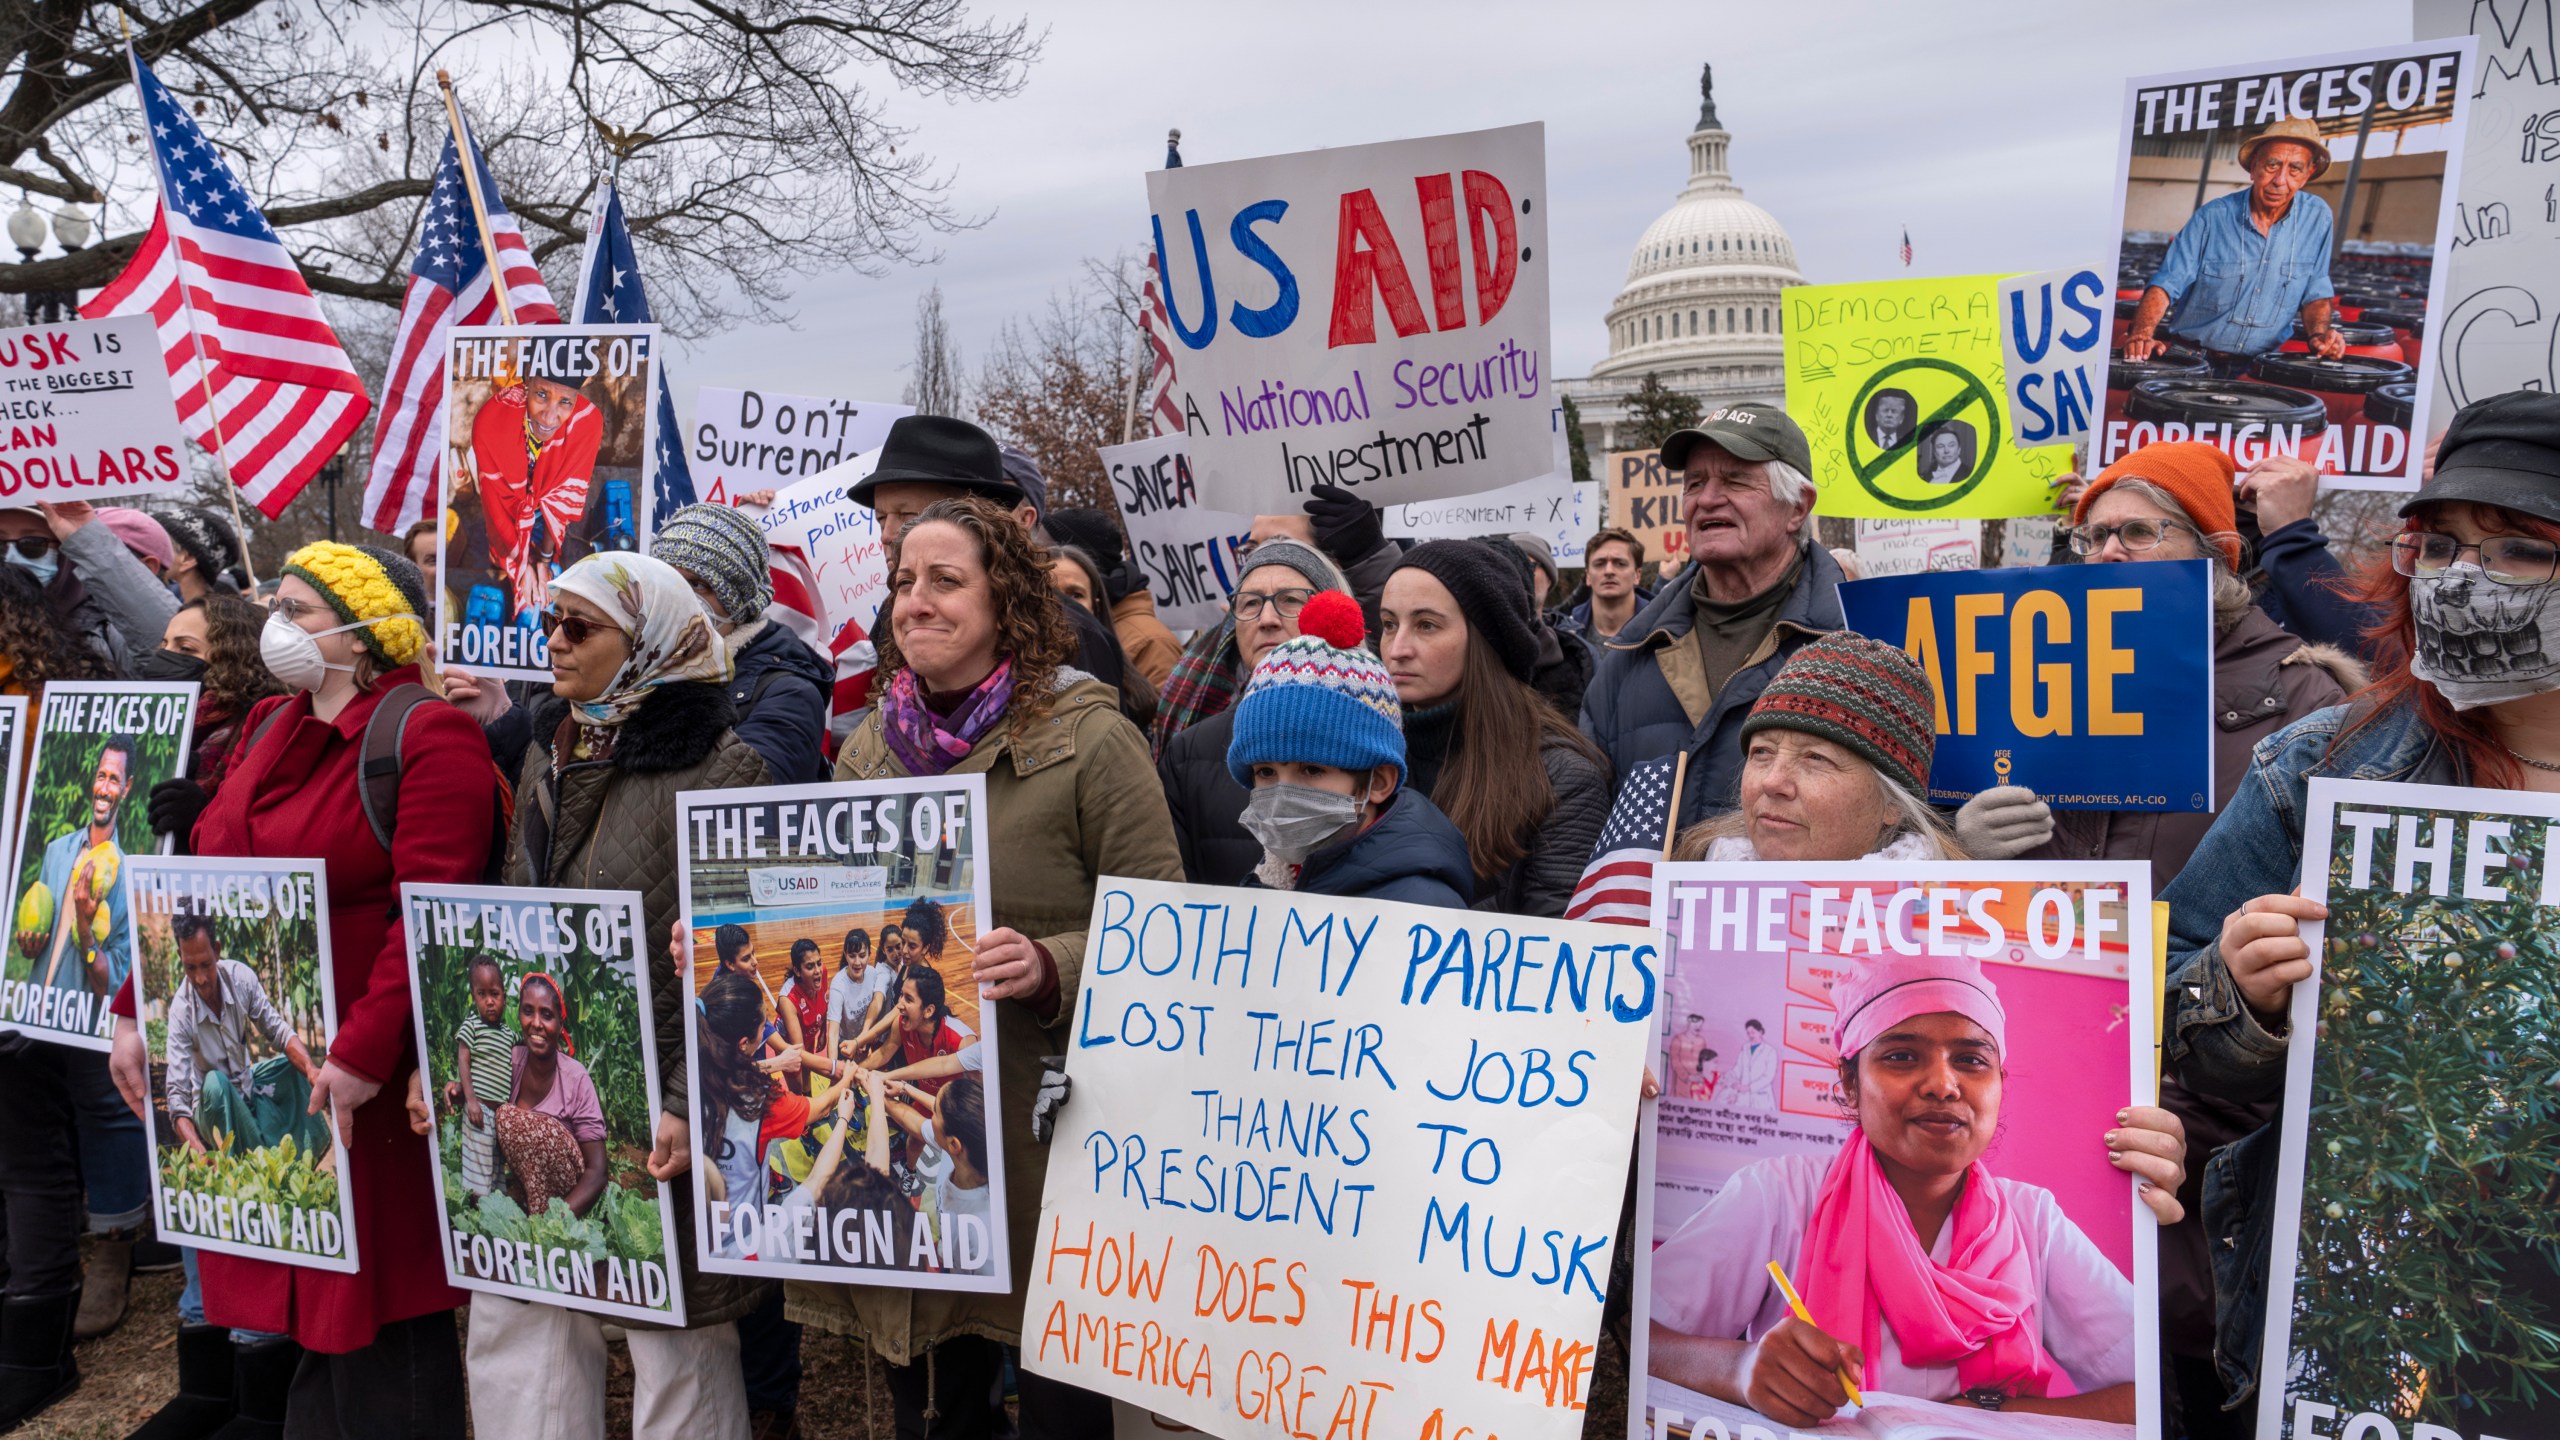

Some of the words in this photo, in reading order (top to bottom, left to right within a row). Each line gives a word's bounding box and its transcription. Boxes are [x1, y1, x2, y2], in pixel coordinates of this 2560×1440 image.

[2140, 84, 2222, 136] THE
[2233, 66, 2375, 127] FACES
[2386, 57, 2455, 111] OF
[1794, 291, 1990, 332] DEMOCRA
[2010, 270, 2105, 365] US
[0, 331, 81, 371] USK
[93, 333, 122, 354] IS
[455, 340, 507, 378] THE
[516, 338, 600, 378] FACES
[608, 337, 647, 378] OF
[1797, 341, 1840, 371] DO
[5, 380, 42, 393] THE
[47, 370, 134, 391] BIGGEST
[1186, 392, 1210, 437] A
[1219, 370, 1371, 436] National
[1393, 338, 1539, 408] Security
[741, 391, 858, 438] Don't
[1727, 409, 1757, 425] ACT
[0, 445, 180, 497] DOLLARS
[1282, 413, 1491, 494] Investment
[1814, 449, 1846, 489] USA
[2315, 424, 2407, 474] AID
[1113, 454, 1177, 516] SAVE
[1547, 497, 1563, 522] X
[807, 508, 878, 559] policy
[1882, 537, 1929, 551] makes
[840, 571, 888, 605] have
[1139, 540, 1217, 608] SAVE
[1865, 556, 1925, 578] AMERICA
[1932, 552, 1975, 571] SAFER
[1904, 587, 2144, 738] AFGE
[48, 695, 85, 733] THE
[88, 695, 150, 734] FACES
[155, 696, 186, 736] OF
[1994, 749, 2012, 759] AFGE
[1930, 789, 1973, 801] FEDERATION
[2058, 794, 2123, 807] EMPLOYEES,
[2125, 796, 2167, 806] AFL-CIO
[691, 805, 767, 861] THE
[778, 798, 899, 858] FACES
[911, 795, 967, 851] OF
[2340, 810, 2511, 902] THE
[134, 871, 186, 916] THE
[189, 872, 270, 920] FACES
[276, 875, 314, 921] OF
[778, 877, 819, 891] USAID
[413, 900, 475, 948] THE
[482, 903, 578, 954] FACES
[585, 908, 629, 957] OF
[1673, 887, 1787, 953] THE
[1808, 887, 2006, 958] FACES
[2026, 887, 2120, 961] OF
[1097, 890, 1257, 988] BOTH
[1273, 907, 1379, 996] MY
[1401, 923, 1658, 1024] PARENTS
[0, 979, 94, 1034] FOREIGN
[1080, 990, 1214, 1056] LOST
[1247, 1012, 1397, 1090] THEIR
[1426, 1038, 1596, 1107] JOBS
[1191, 1089, 1372, 1166] THANKS
[1418, 1123, 1501, 1185] TO
[162, 1187, 284, 1252] FOREIGN
[290, 1205, 343, 1257] AID
[711, 1201, 896, 1266] FOREIGN
[909, 1212, 990, 1271] AID
[1084, 1131, 1375, 1237] PRESIDENT
[1418, 1197, 1608, 1302] MUSK
[452, 1231, 598, 1299] FOREIGN
[606, 1256, 669, 1310] AID
[1046, 1215, 1174, 1302] HOW
[1194, 1244, 1307, 1326] DOES
[1342, 1279, 1446, 1364] THIS
[1476, 1317, 1595, 1411] MAKE
[1039, 1300, 1213, 1399] AMERICA
[1236, 1349, 1395, 1440] GREAT
